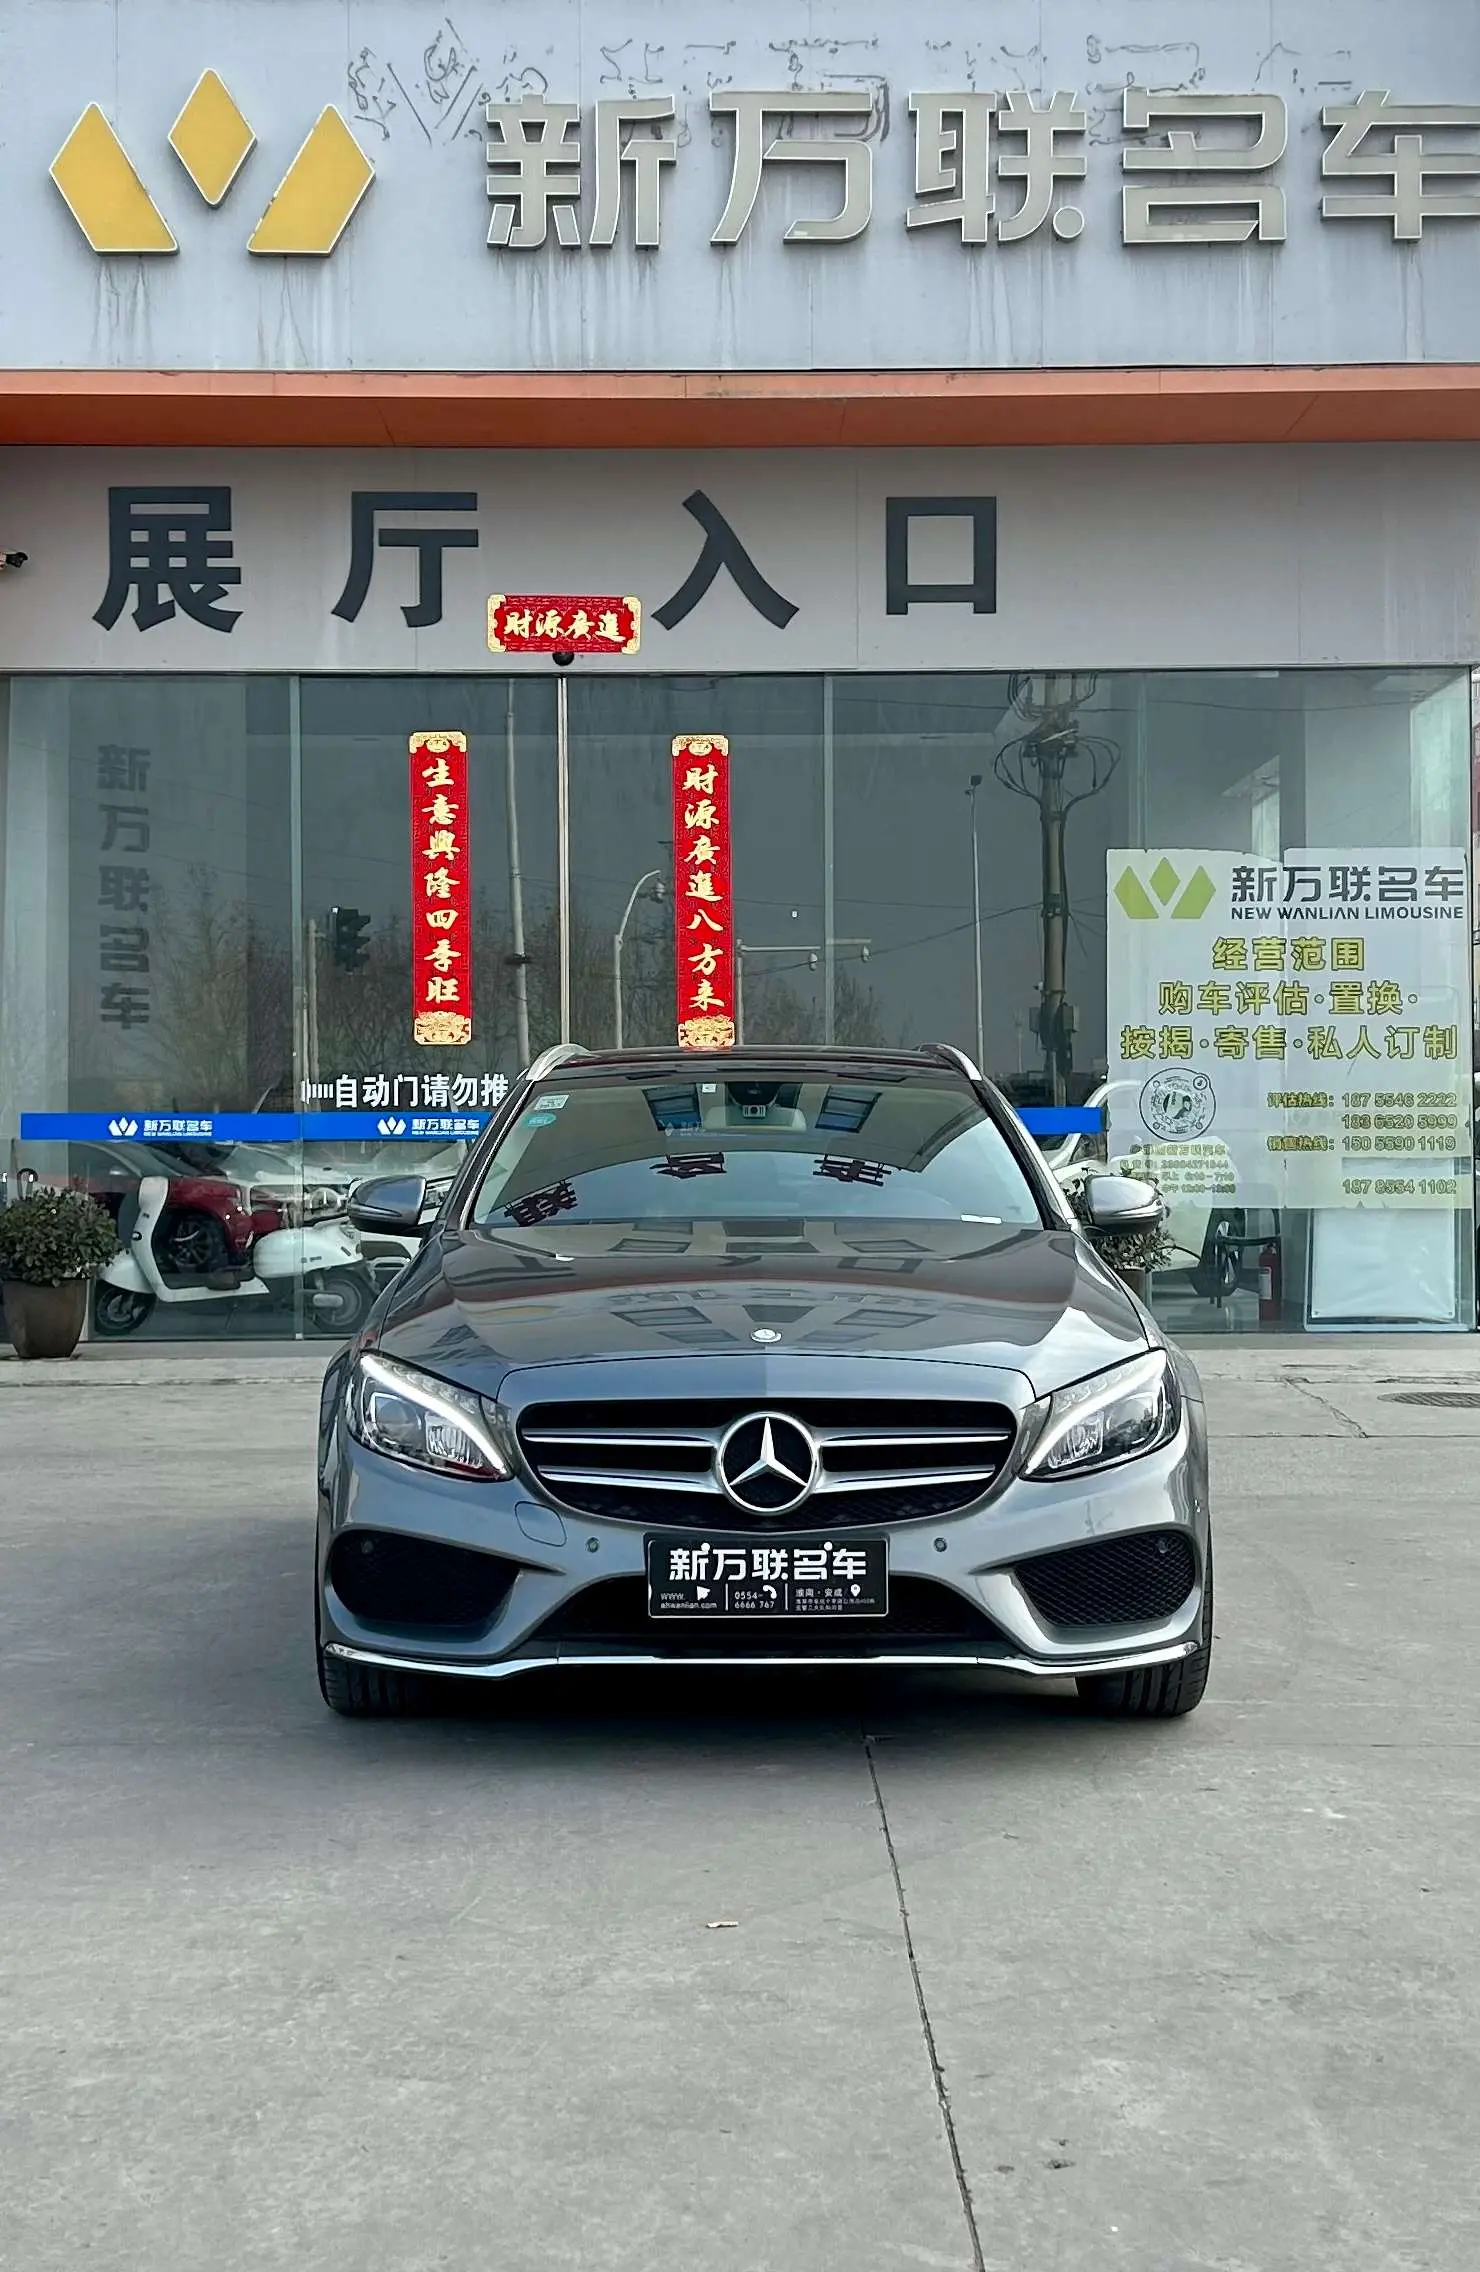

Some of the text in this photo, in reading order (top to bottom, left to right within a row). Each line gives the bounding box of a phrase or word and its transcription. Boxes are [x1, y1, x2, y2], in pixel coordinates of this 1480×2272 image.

[486, 89, 1480, 250] 新万联名车
[92, 486, 998, 633] 展厅入口
[97, 744, 150, 1031] 新万联名车
[1231, 865, 1464, 902] 新万联名车
[1231, 906, 1464, 920] NEW WANLIAN LIMOUSINE
[1212, 936, 1365, 972] 经营范围
[336, 1073, 509, 1108] 自动门请勿推
[669, 1548, 867, 1581] 新万联名车
